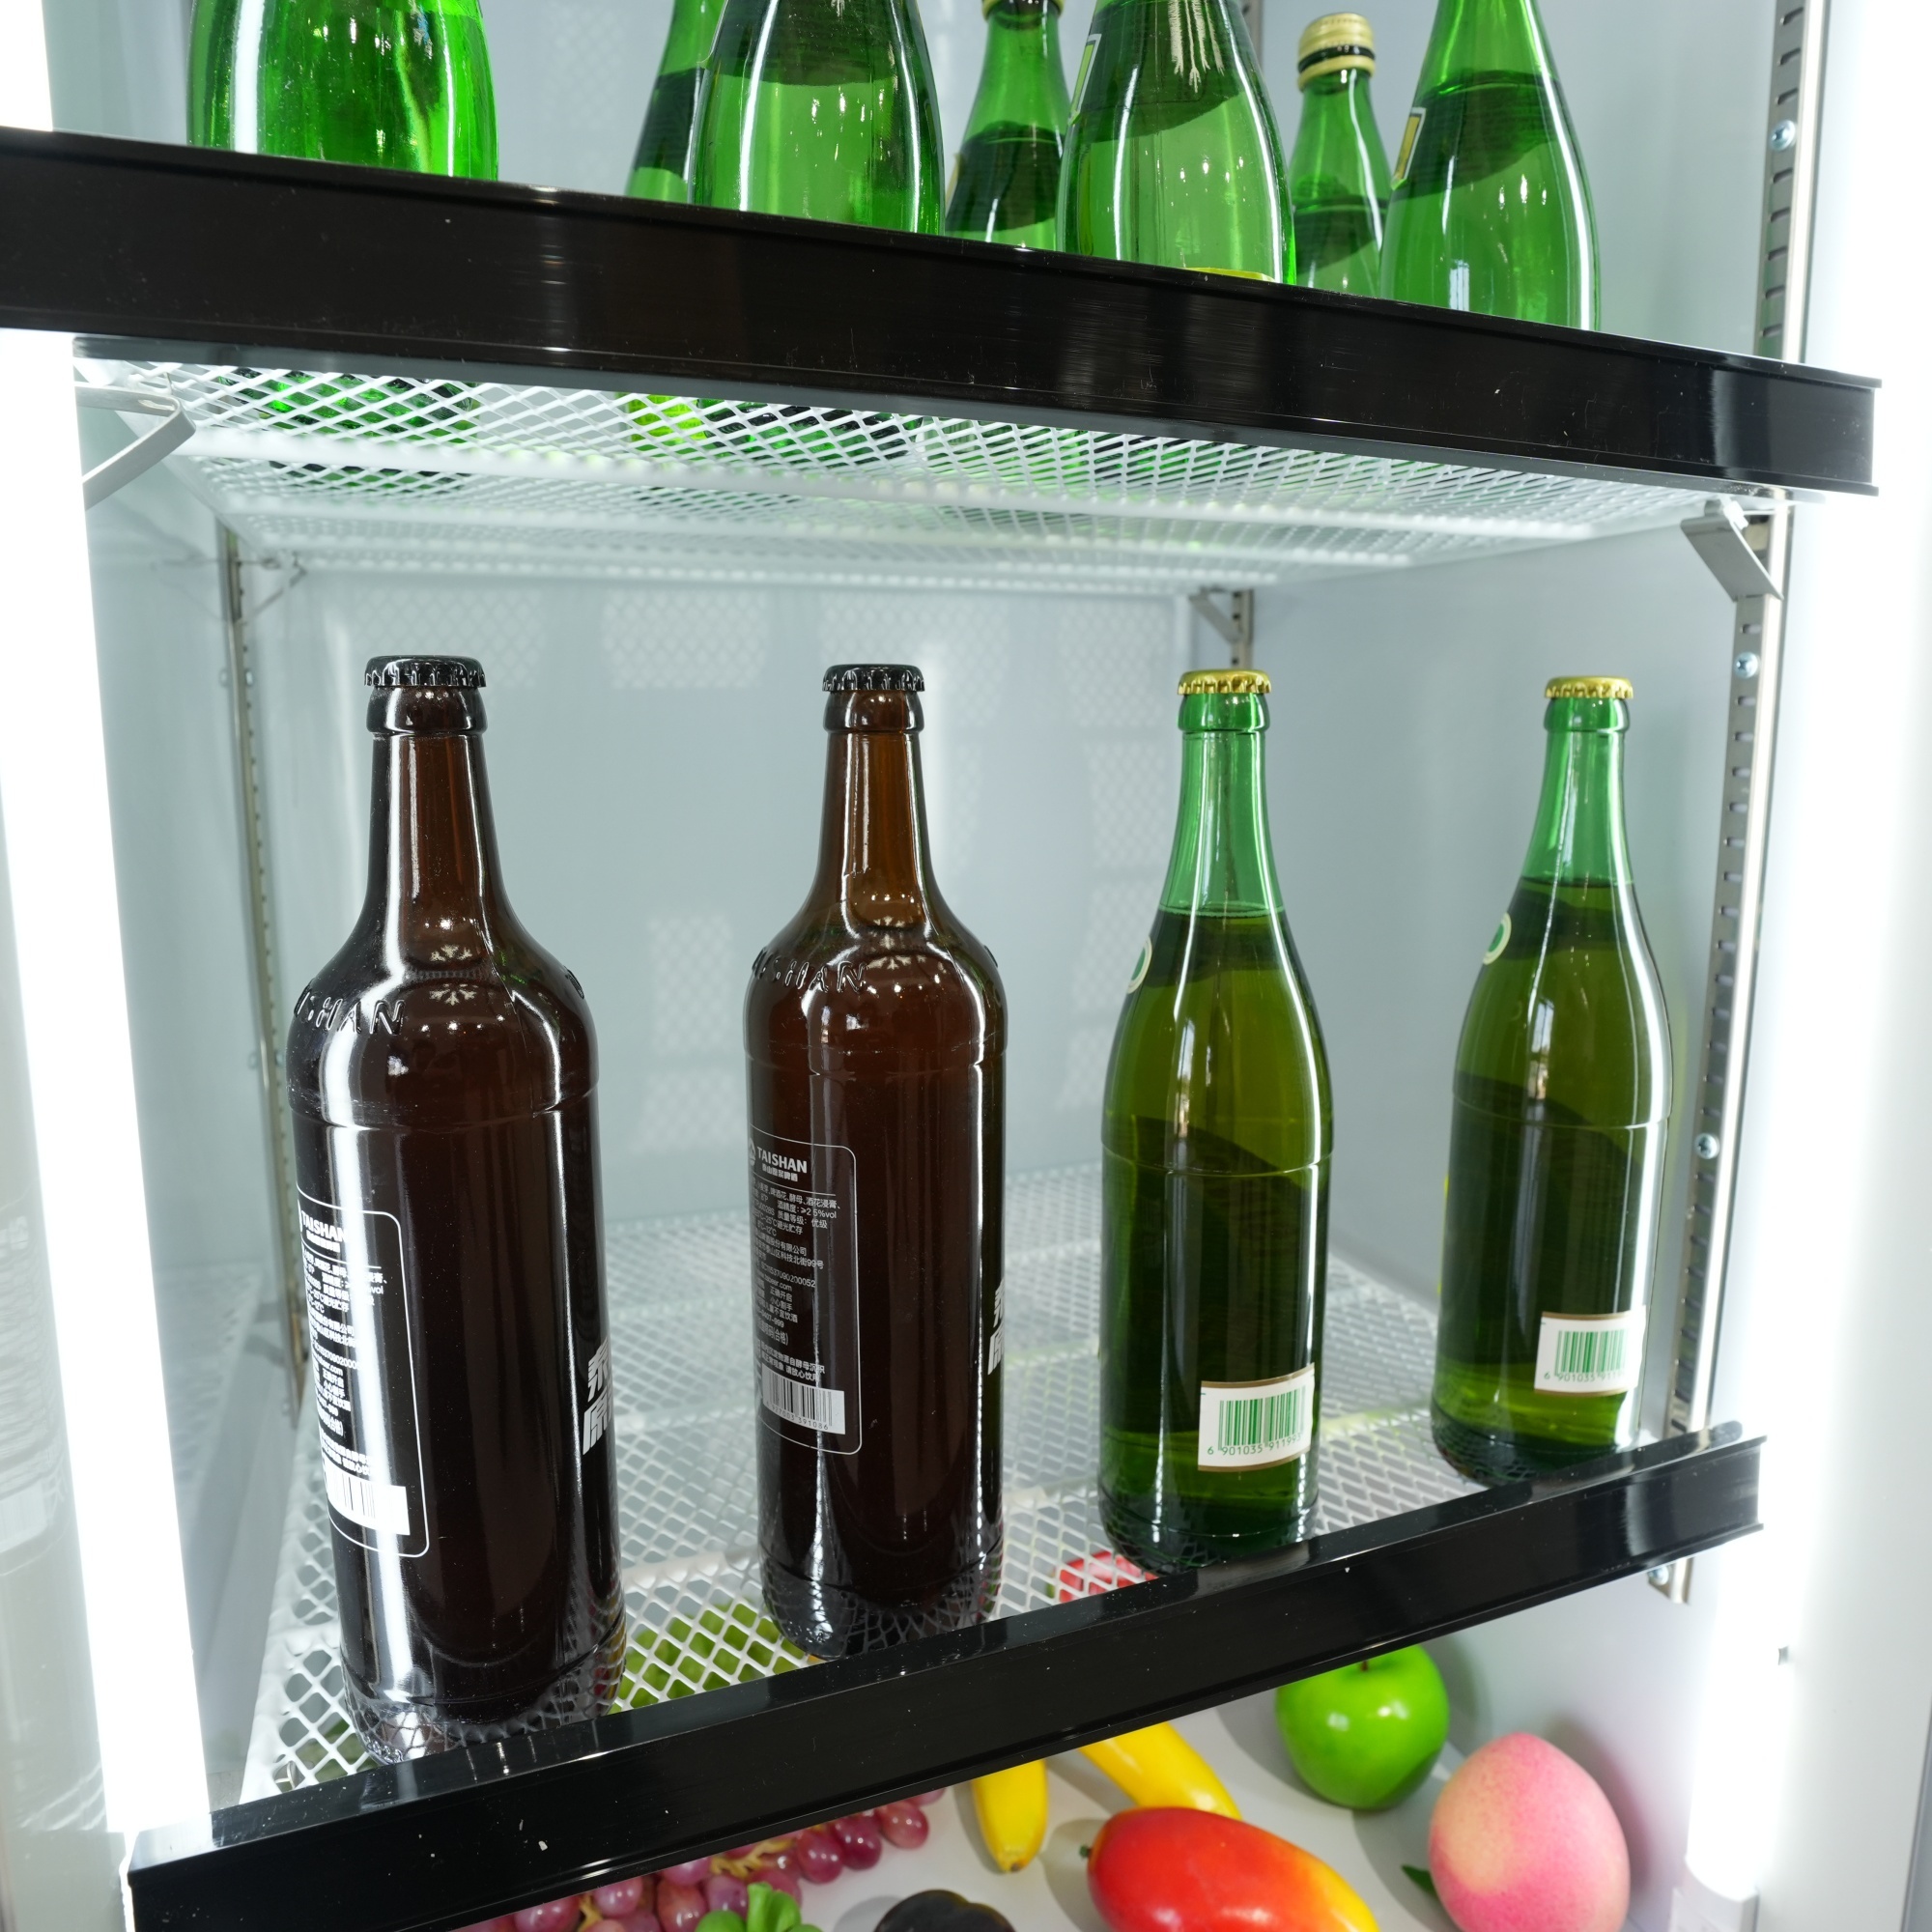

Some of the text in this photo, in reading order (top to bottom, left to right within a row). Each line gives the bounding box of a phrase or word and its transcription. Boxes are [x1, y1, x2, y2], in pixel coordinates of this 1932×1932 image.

[756, 1147, 808, 1174] TAISHAN
[811, 1218, 828, 1230] 优级
[1544, 1372, 1551, 1380] 6
[1555, 1372, 1596, 1382] 901035
[798, 1416, 829, 1431] 391086
[1207, 1445, 1215, 1456] 6
[1222, 1443, 1264, 1457] 901035
